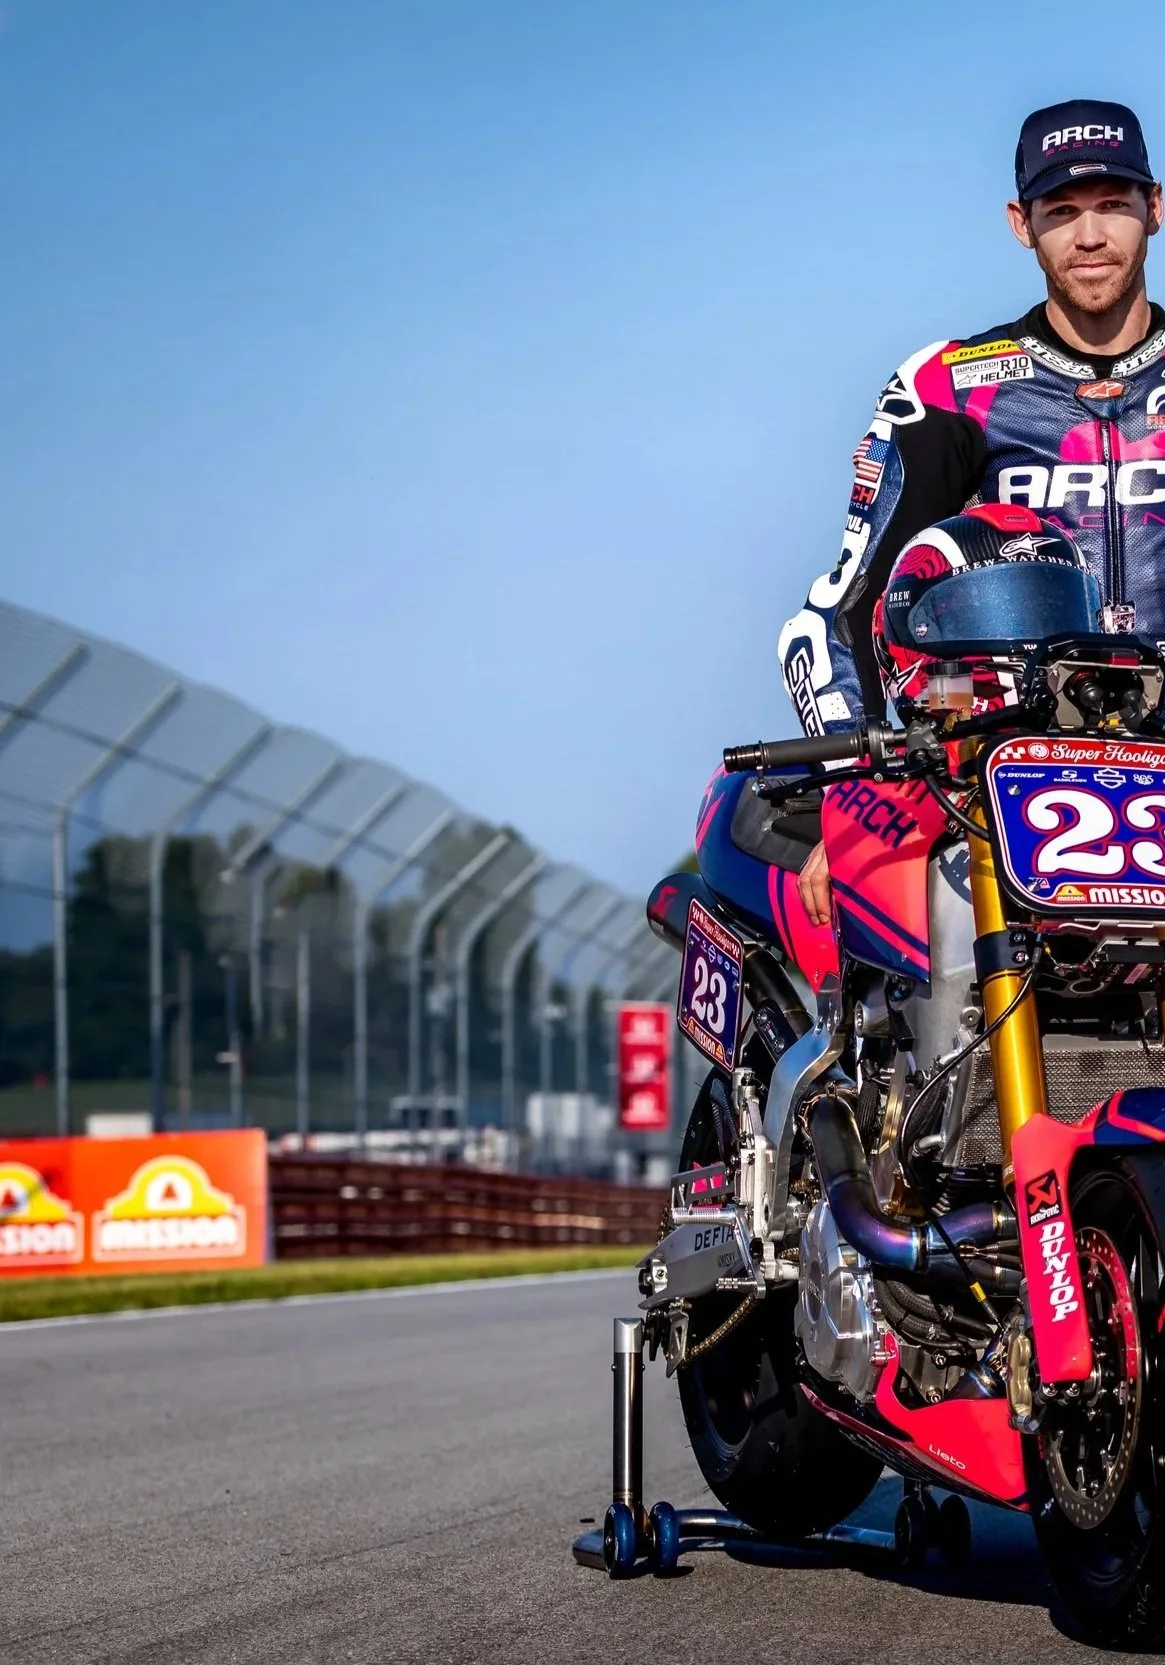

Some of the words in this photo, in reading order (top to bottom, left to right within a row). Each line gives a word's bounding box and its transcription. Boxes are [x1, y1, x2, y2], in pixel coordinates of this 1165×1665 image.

[1042, 125, 1124, 151] ARCH
[1046, 141, 1120, 158] RACING
[955, 360, 999, 375] SUPERTECH
[1000, 356, 1029, 372] R10
[980, 367, 1029, 383] HELMET
[889, 590, 910, 602] BREW
[1051, 743, 1102, 763] Super
[827, 779, 919, 850] ARCH
[691, 956, 727, 1034] 23
[1039, 1221, 1079, 1322] DUNLOP
